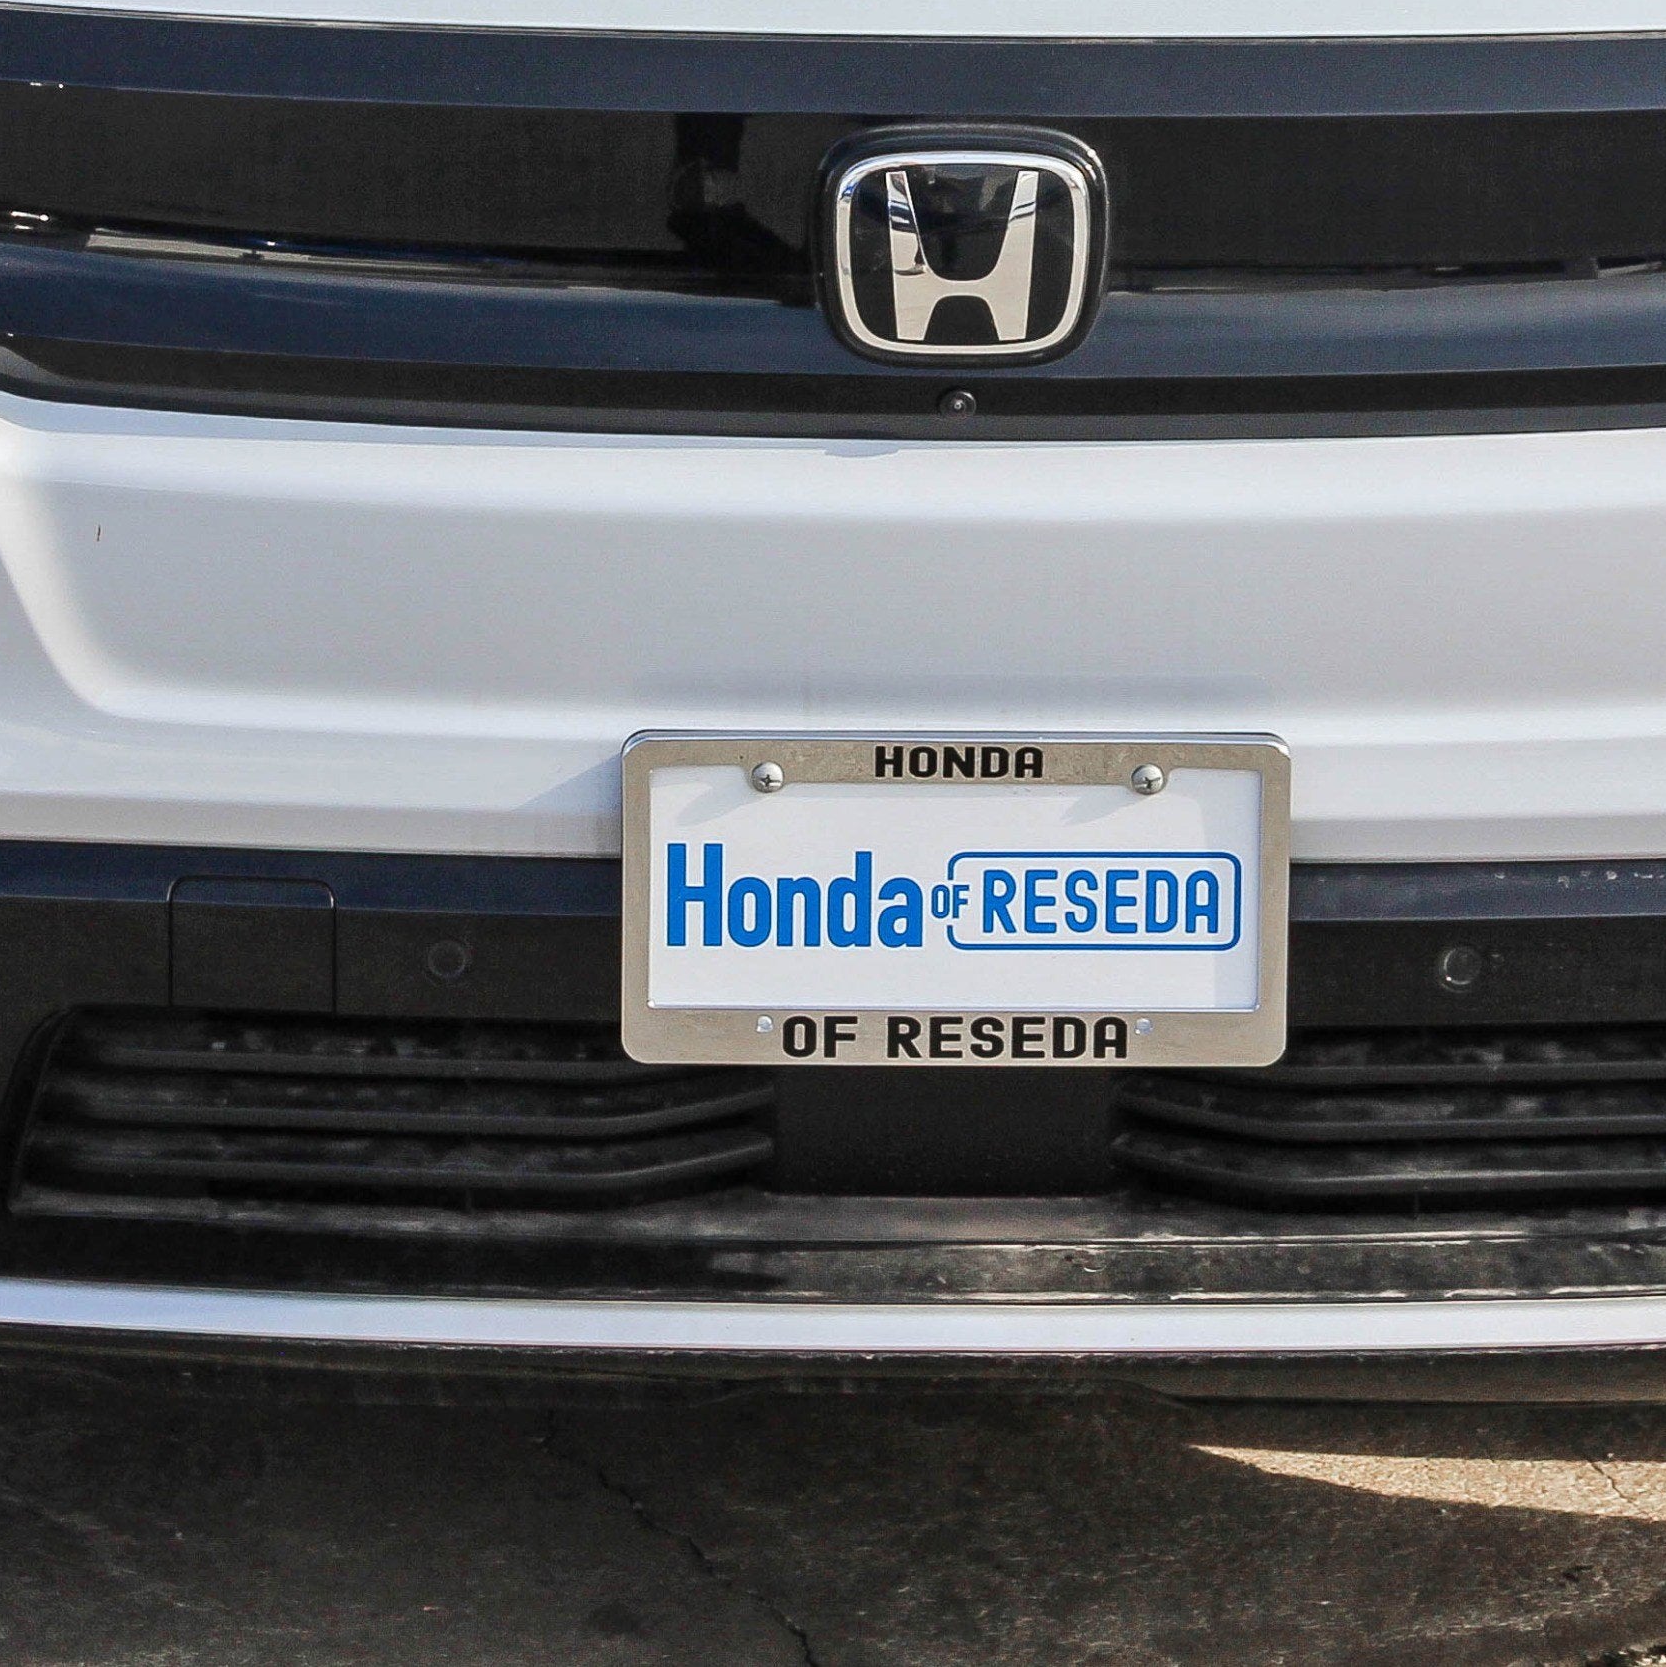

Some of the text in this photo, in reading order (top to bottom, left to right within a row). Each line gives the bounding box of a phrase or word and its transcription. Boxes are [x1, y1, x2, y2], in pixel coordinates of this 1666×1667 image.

[874, 747, 1044, 779] HONDA
[666, 842, 1219, 948] Honda OF RESEDA
[781, 1017, 1129, 1060] OF RESEDA
